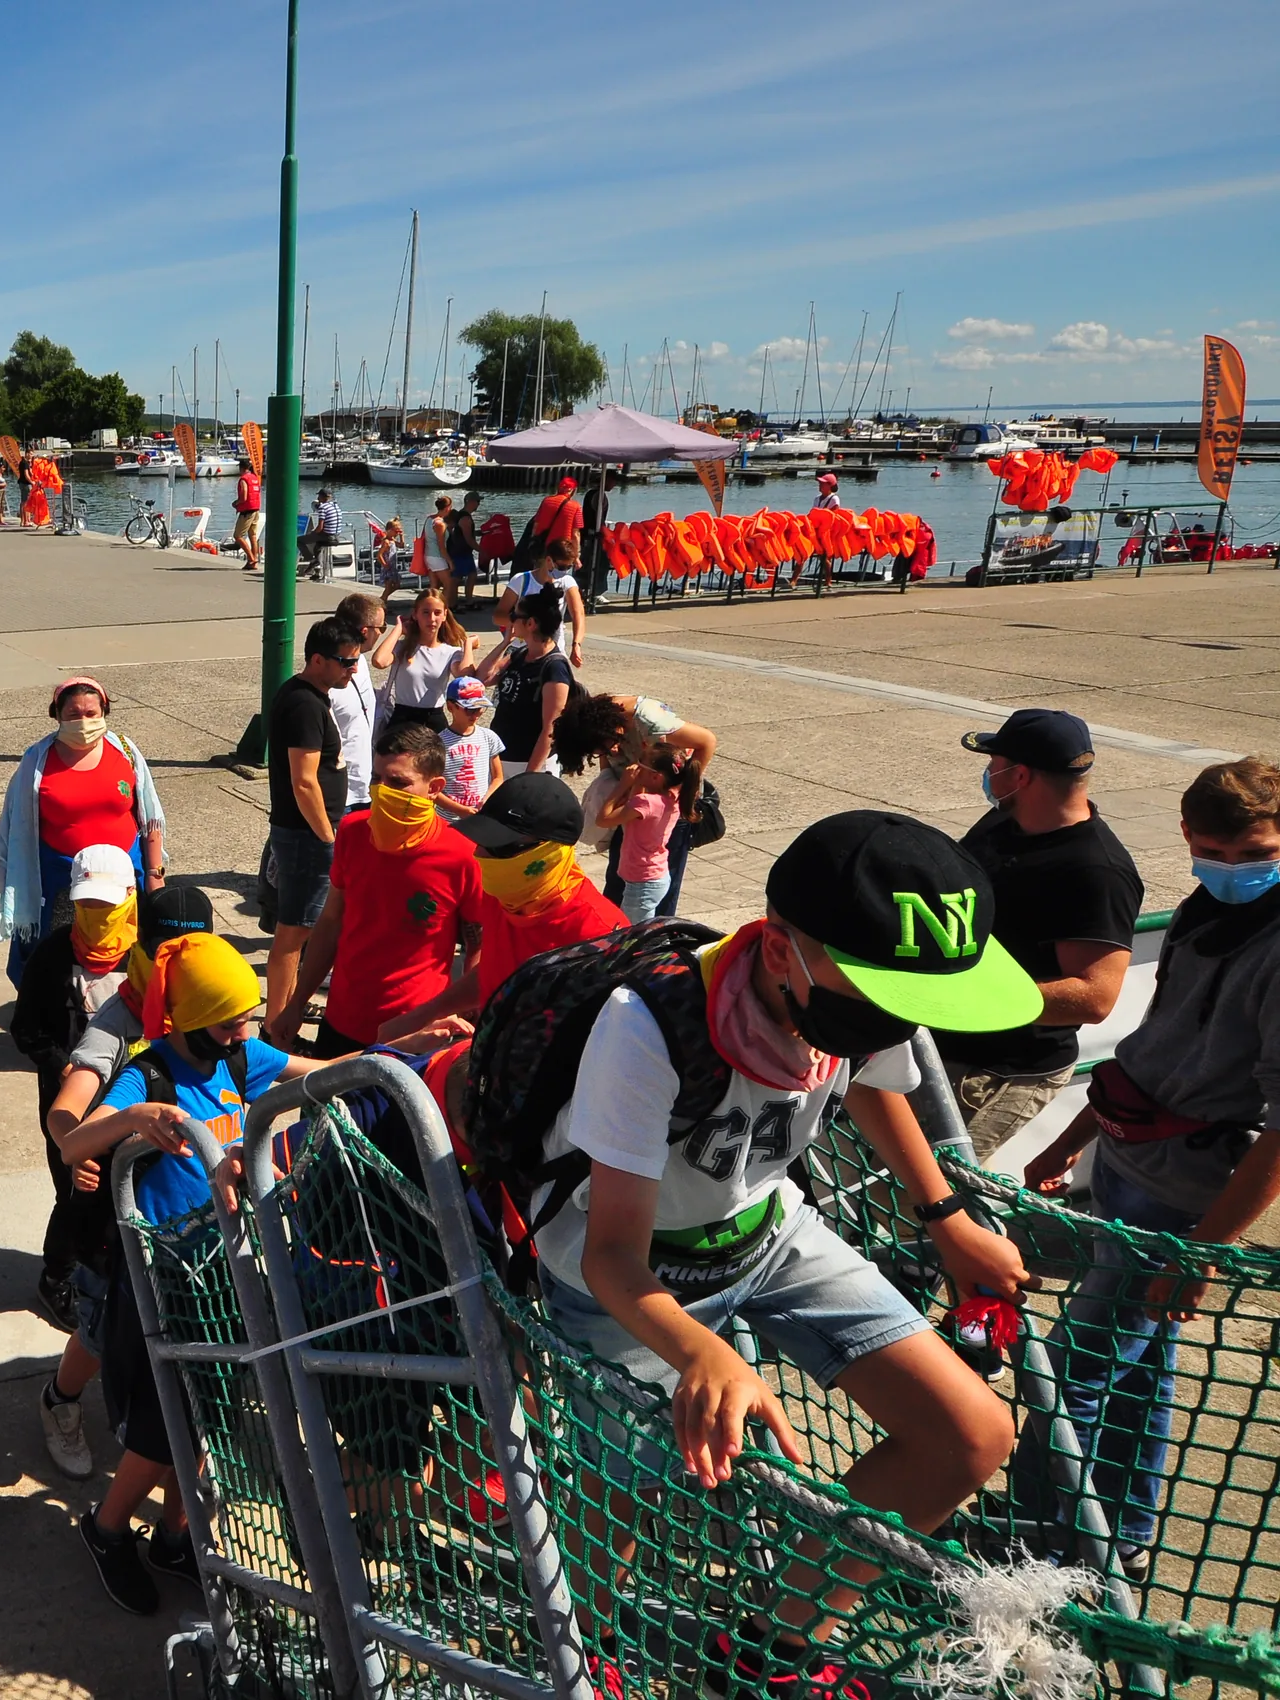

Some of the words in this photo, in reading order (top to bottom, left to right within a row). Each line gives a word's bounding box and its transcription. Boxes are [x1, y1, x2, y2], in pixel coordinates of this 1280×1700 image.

[449, 744, 480, 758] AHOY
[892, 887, 978, 959] NY
[654, 1221, 782, 1282] MINECRAFT
